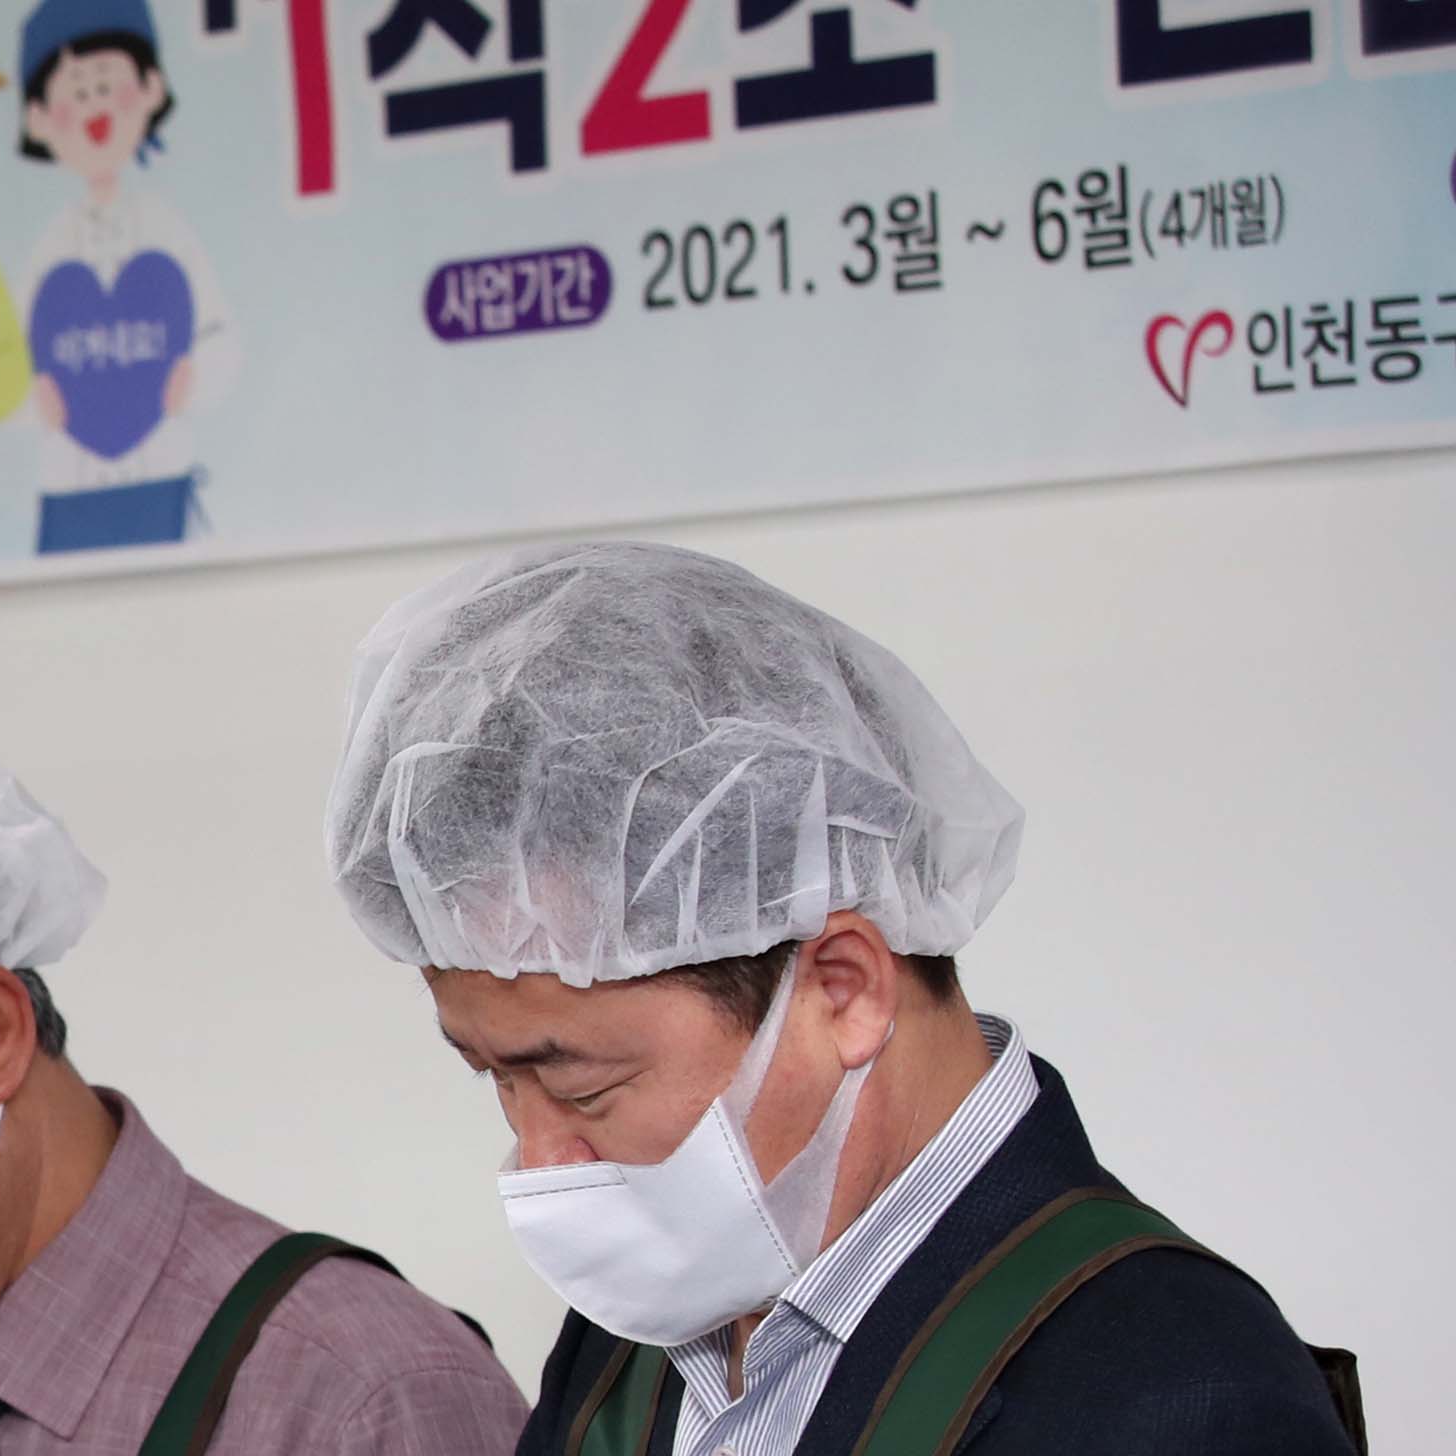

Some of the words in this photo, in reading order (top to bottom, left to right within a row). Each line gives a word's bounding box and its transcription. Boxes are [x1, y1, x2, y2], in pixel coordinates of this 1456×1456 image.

[438, 252, 596, 336] 사업기간
[641, 213, 818, 312] 2021.
[840, 188, 944, 296] 3월
